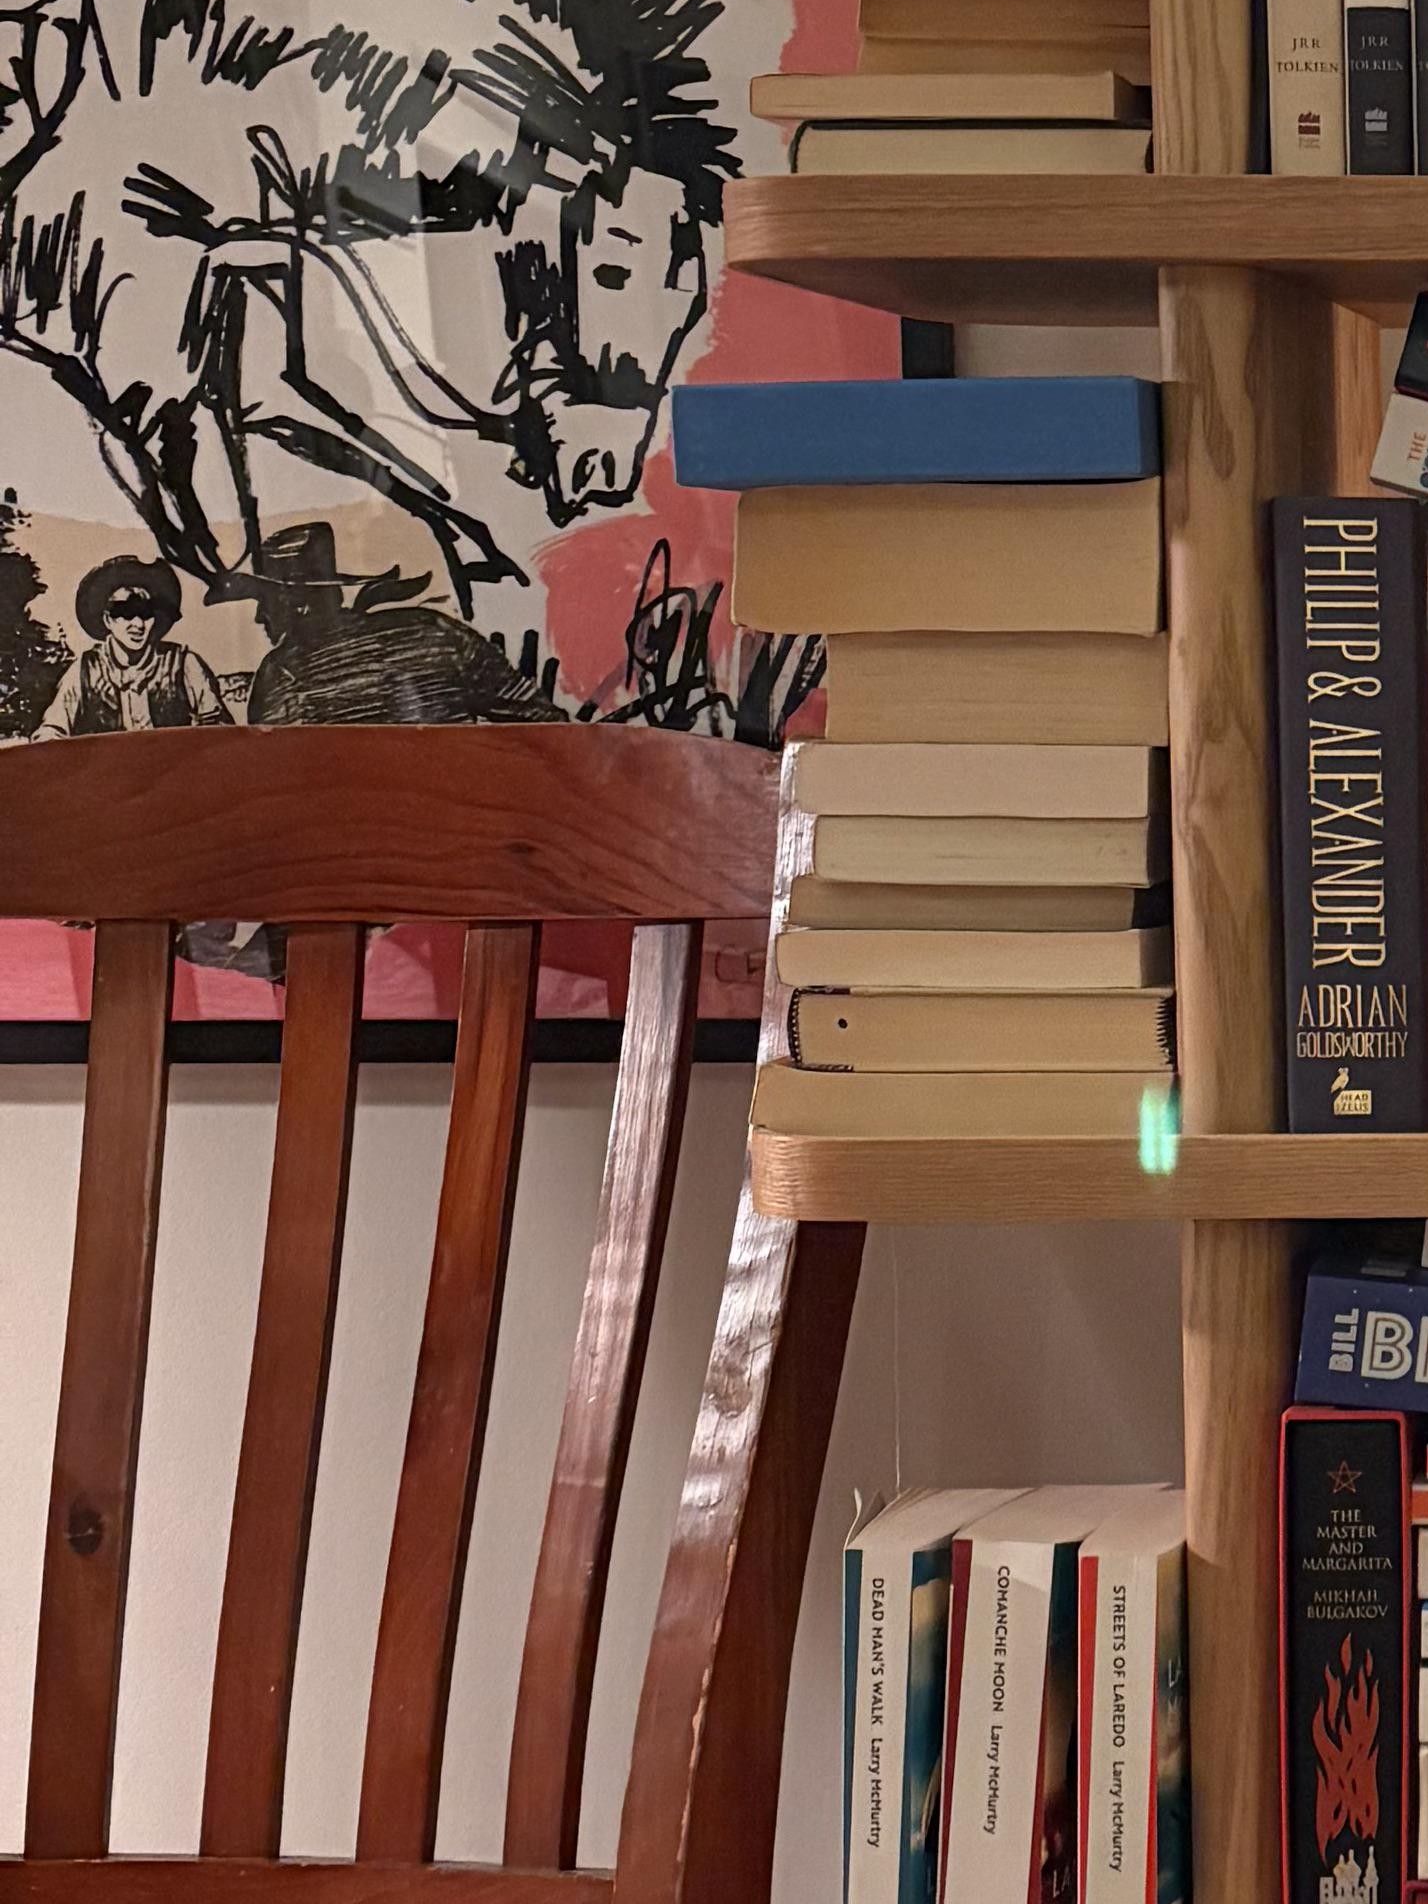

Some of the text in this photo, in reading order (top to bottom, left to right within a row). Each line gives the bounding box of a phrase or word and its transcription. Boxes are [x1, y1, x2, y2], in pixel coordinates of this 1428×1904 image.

[1304, 516, 1387, 970] PHILIP & ALEXANDER
[1298, 985, 1407, 1029] ADRIAN
[1297, 1031, 1407, 1059] GOLDSWORTHY
[1328, 1308, 1359, 1371] BILL
[1108, 1585, 1125, 1873] STREETS OF LAREDO Larry McMurtry
